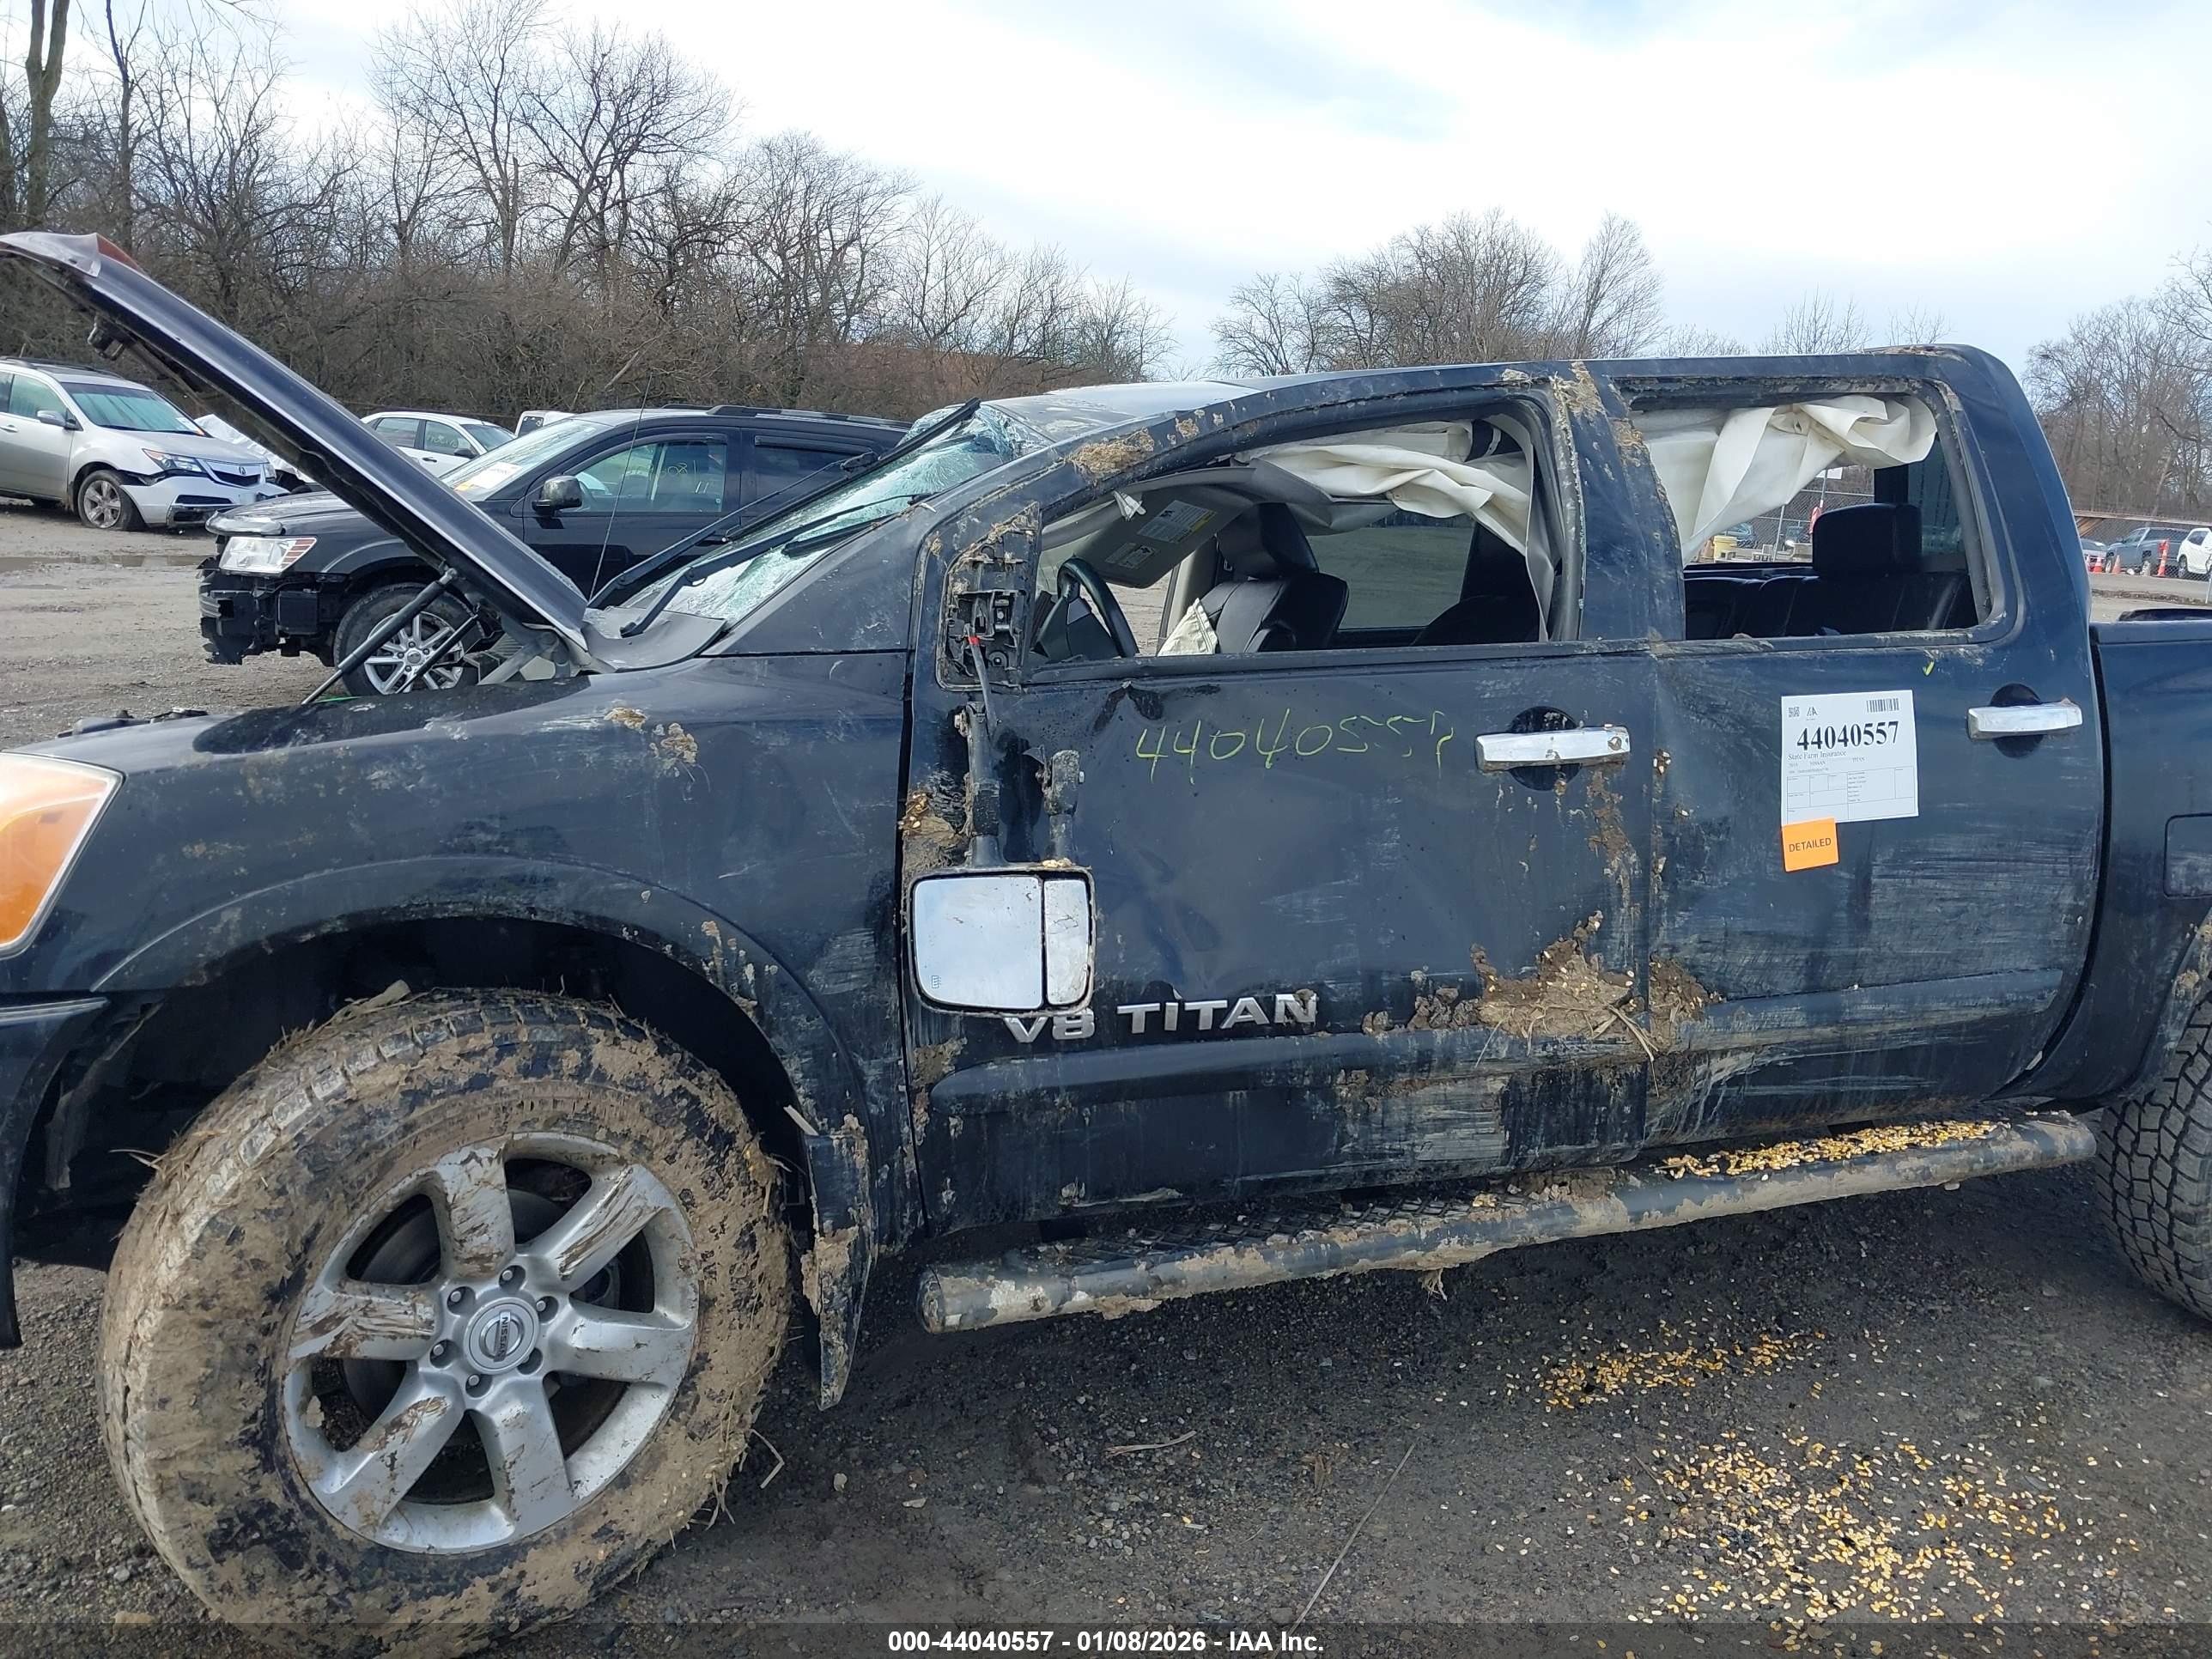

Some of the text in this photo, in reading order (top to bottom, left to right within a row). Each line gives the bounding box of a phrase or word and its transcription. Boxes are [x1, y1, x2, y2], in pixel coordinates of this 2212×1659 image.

[1796, 720, 1899, 750] 44040557
[1803, 750, 1819, 760] Farm
[1789, 837, 1832, 853] DETAILED
[1003, 992, 1316, 1044] V8 TITAN
[496, 1316, 508, 1358] NISSAN
